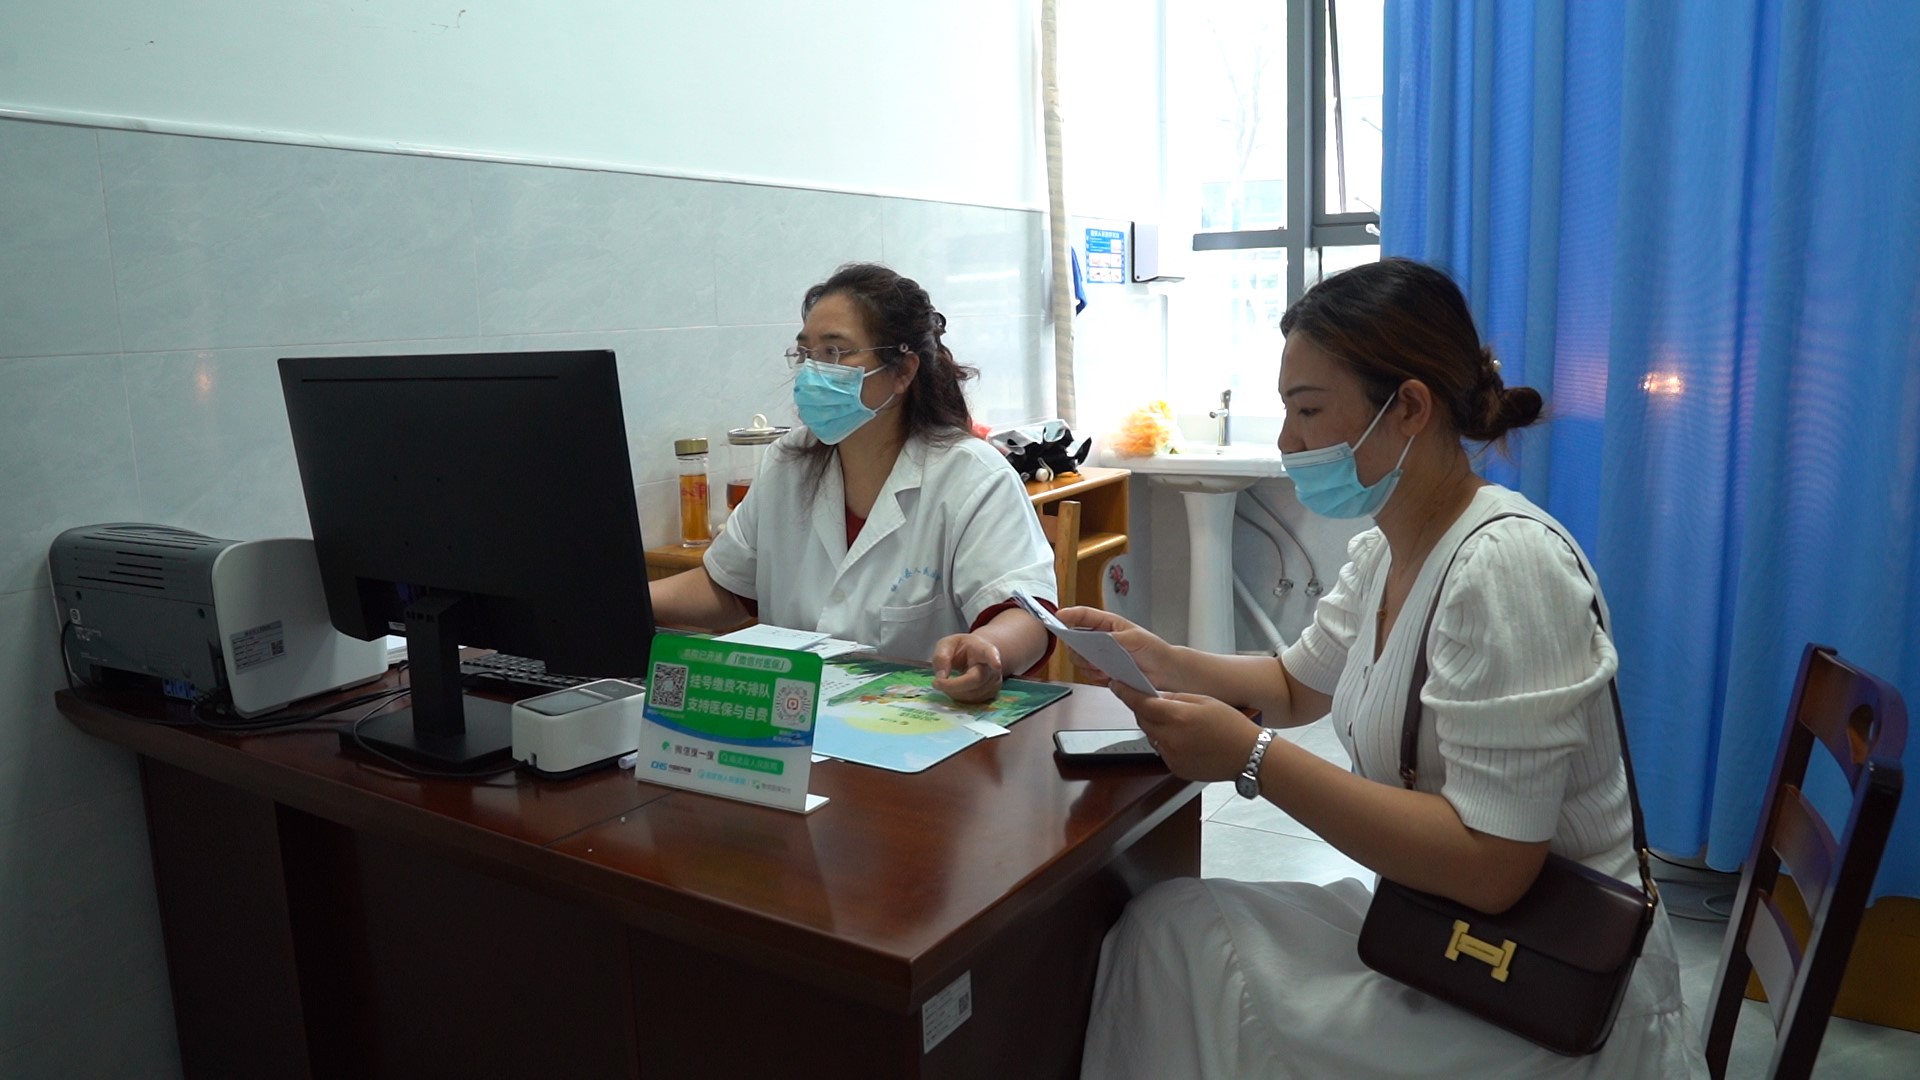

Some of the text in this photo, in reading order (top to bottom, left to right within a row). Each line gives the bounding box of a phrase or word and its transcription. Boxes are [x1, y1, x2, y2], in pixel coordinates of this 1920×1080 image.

[689, 674, 770, 699] 挂号缴费不排队
[687, 697, 768, 723] 支持医保与自费
